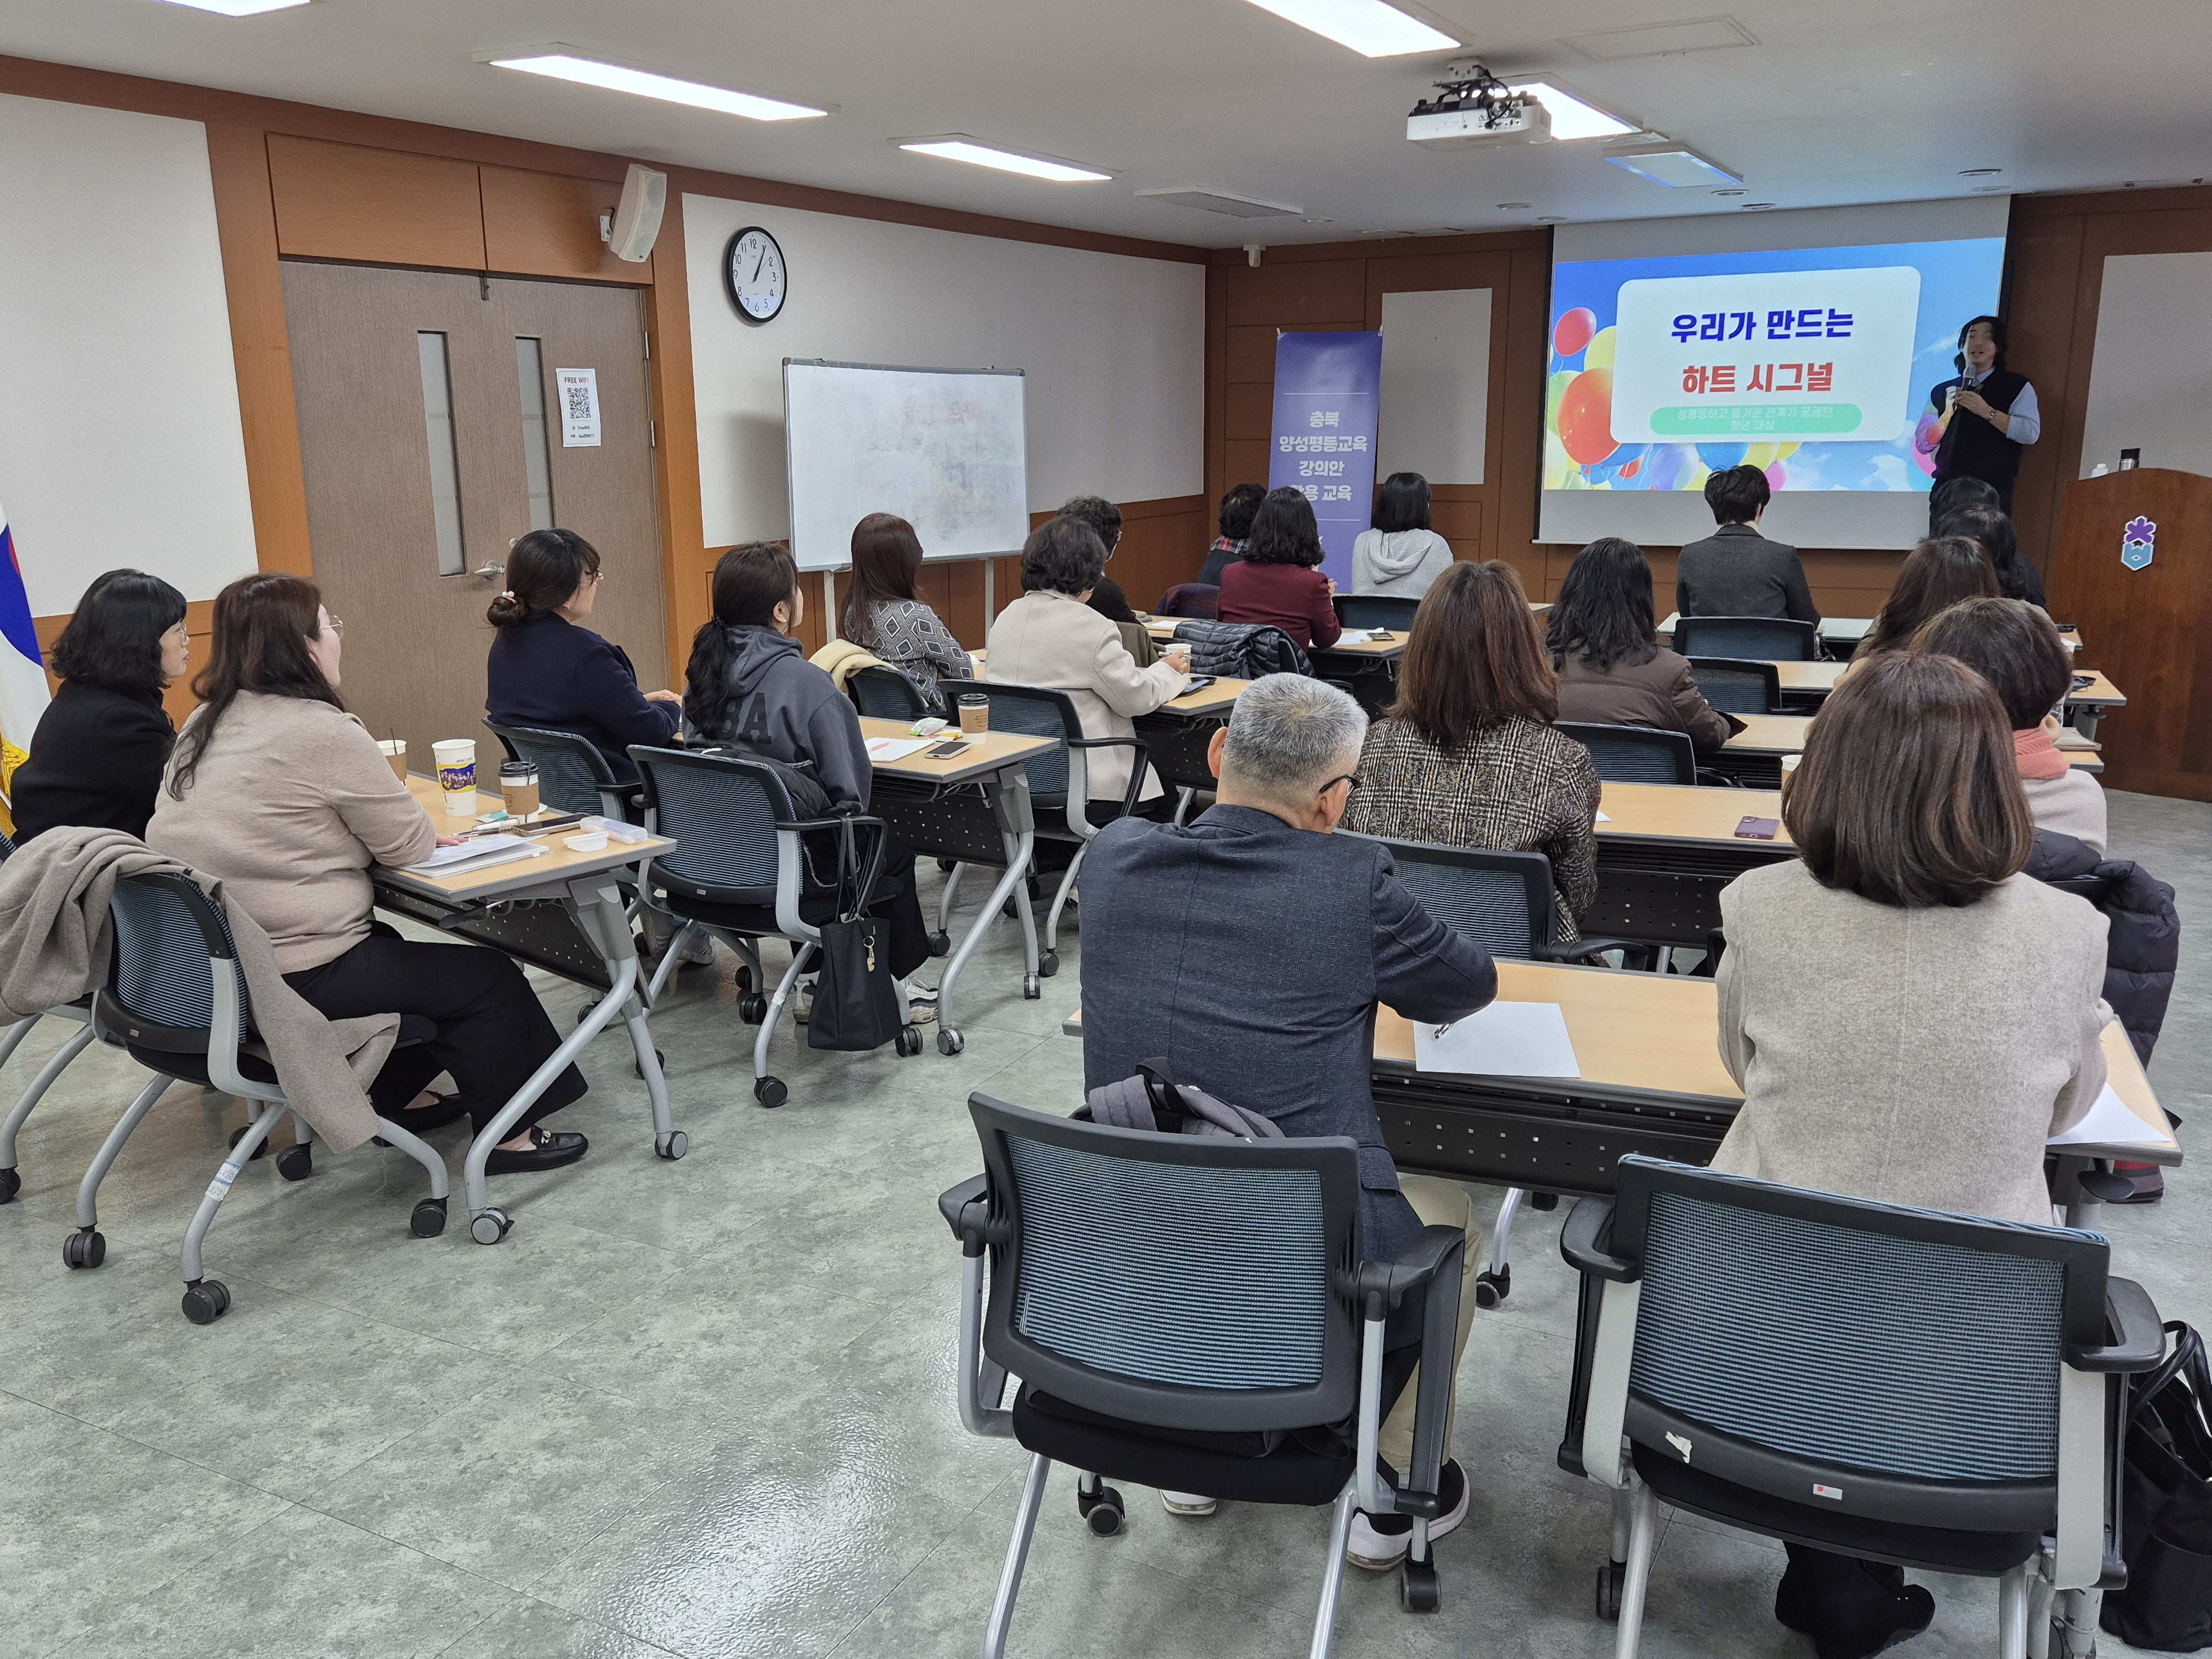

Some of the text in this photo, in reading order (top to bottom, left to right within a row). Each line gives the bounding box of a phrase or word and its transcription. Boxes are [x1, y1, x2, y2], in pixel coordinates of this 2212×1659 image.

[740, 242, 747, 253] 11
[749, 238, 757, 249] 12
[734, 253, 742, 264] 10
[769, 256, 773, 267] 2
[733, 269, 738, 280] 9
[772, 272, 776, 282] 3
[738, 286, 742, 296] 8
[769, 288, 774, 297] 4
[745, 298, 750, 307] 7
[755, 302, 759, 312] 6
[764, 299, 769, 308] 5
[1671, 309, 1854, 343] 우리가 만드는
[1682, 362, 1833, 394] 하트 시그널
[1678, 406, 1834, 420] 성평등하고 즐거운 관계가 궁금한
[1310, 411, 1340, 427] 충북
[1730, 420, 1775, 431] 청년 대상
[1279, 435, 1368, 452] 양성평등교육
[1299, 460, 1345, 477] 강의안
[1322, 484, 1352, 501] 교육
